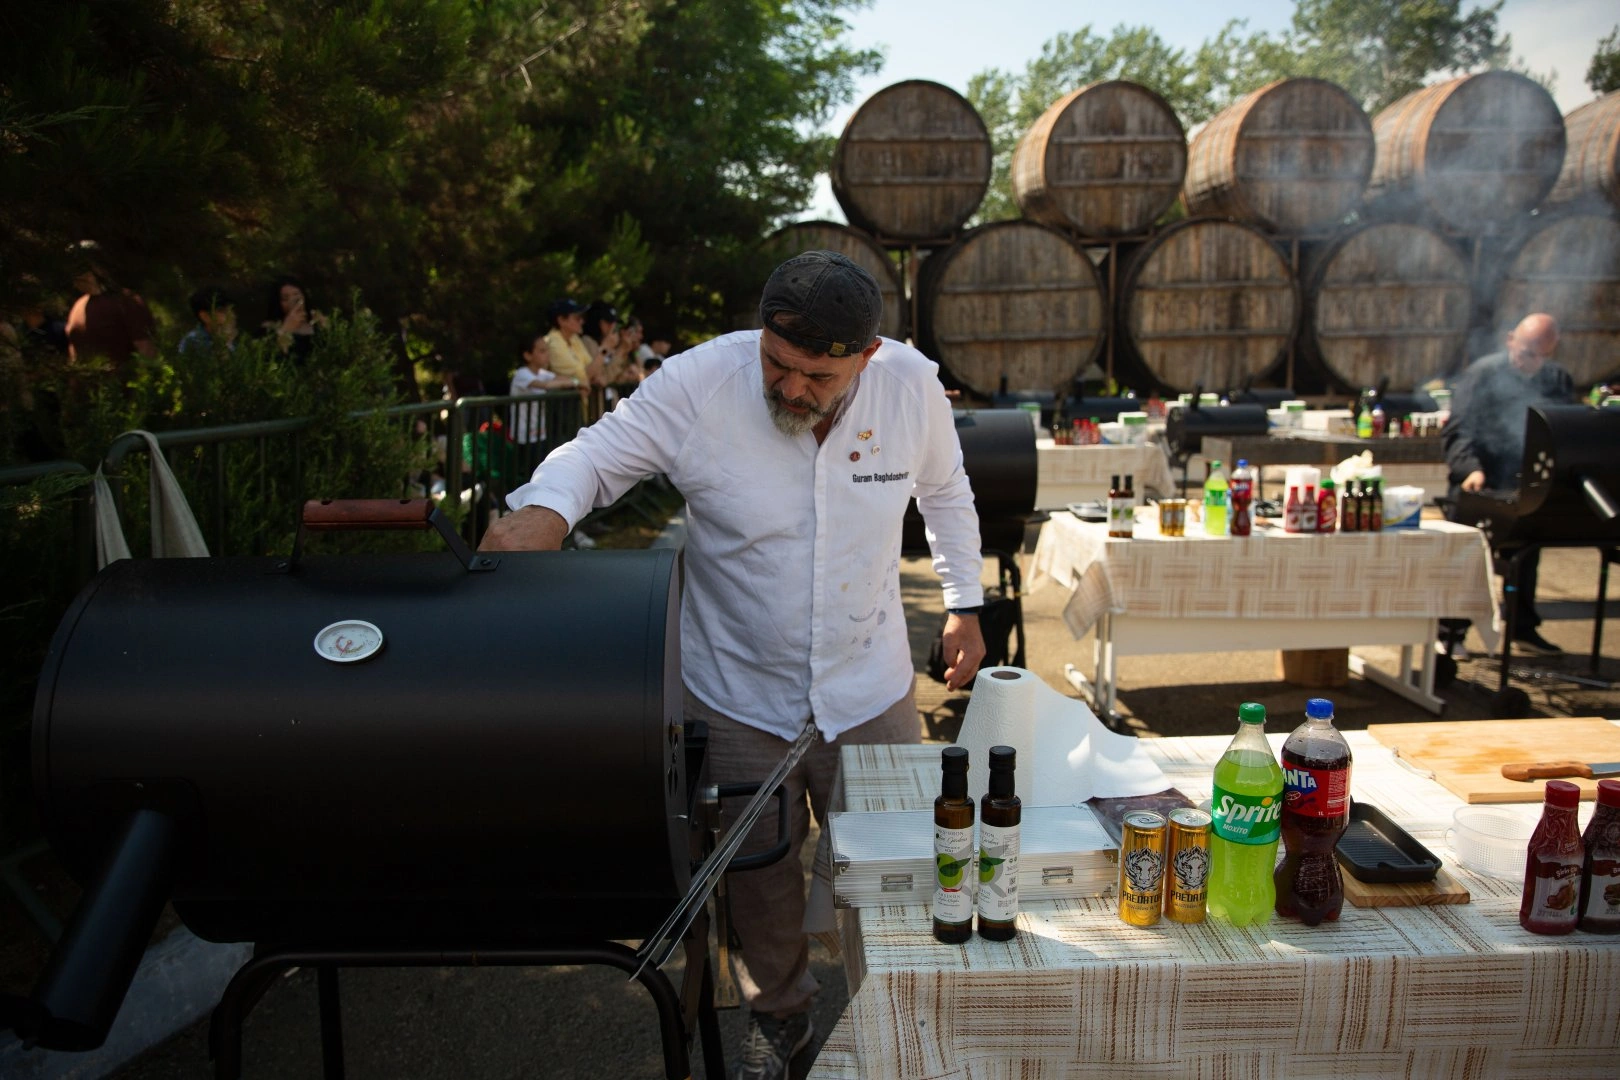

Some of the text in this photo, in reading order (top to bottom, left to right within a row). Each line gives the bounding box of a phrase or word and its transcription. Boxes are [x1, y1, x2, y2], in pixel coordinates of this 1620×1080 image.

[852, 473, 872, 483] Guram
[1282, 767, 1317, 789] ANTA
[1217, 795, 1282, 824] Sprite
[1122, 890, 1161, 904] PREDATO
